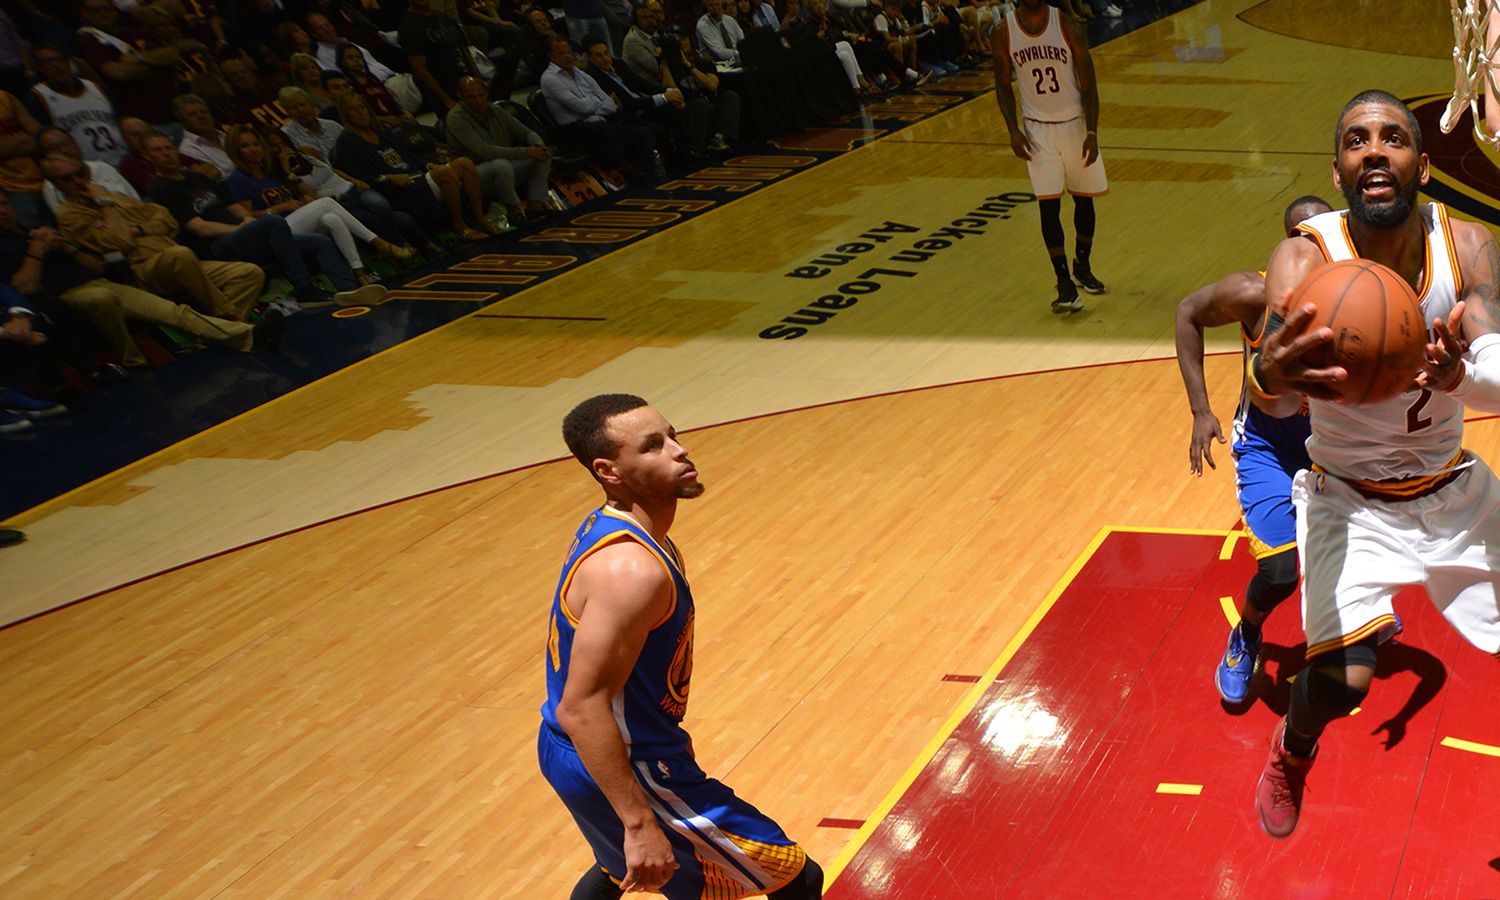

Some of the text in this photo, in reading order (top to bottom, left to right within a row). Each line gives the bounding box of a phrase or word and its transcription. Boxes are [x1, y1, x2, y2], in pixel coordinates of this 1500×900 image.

[1013, 45, 1067, 67] CAVALIERS
[1031, 66, 1060, 94] 23
[84, 126, 118, 152] 23
[655, 154, 819, 193] ONE
[518, 197, 717, 244] FOR
[758, 191, 1036, 341] Quicken Loans
[783, 220, 921, 279] Arena
